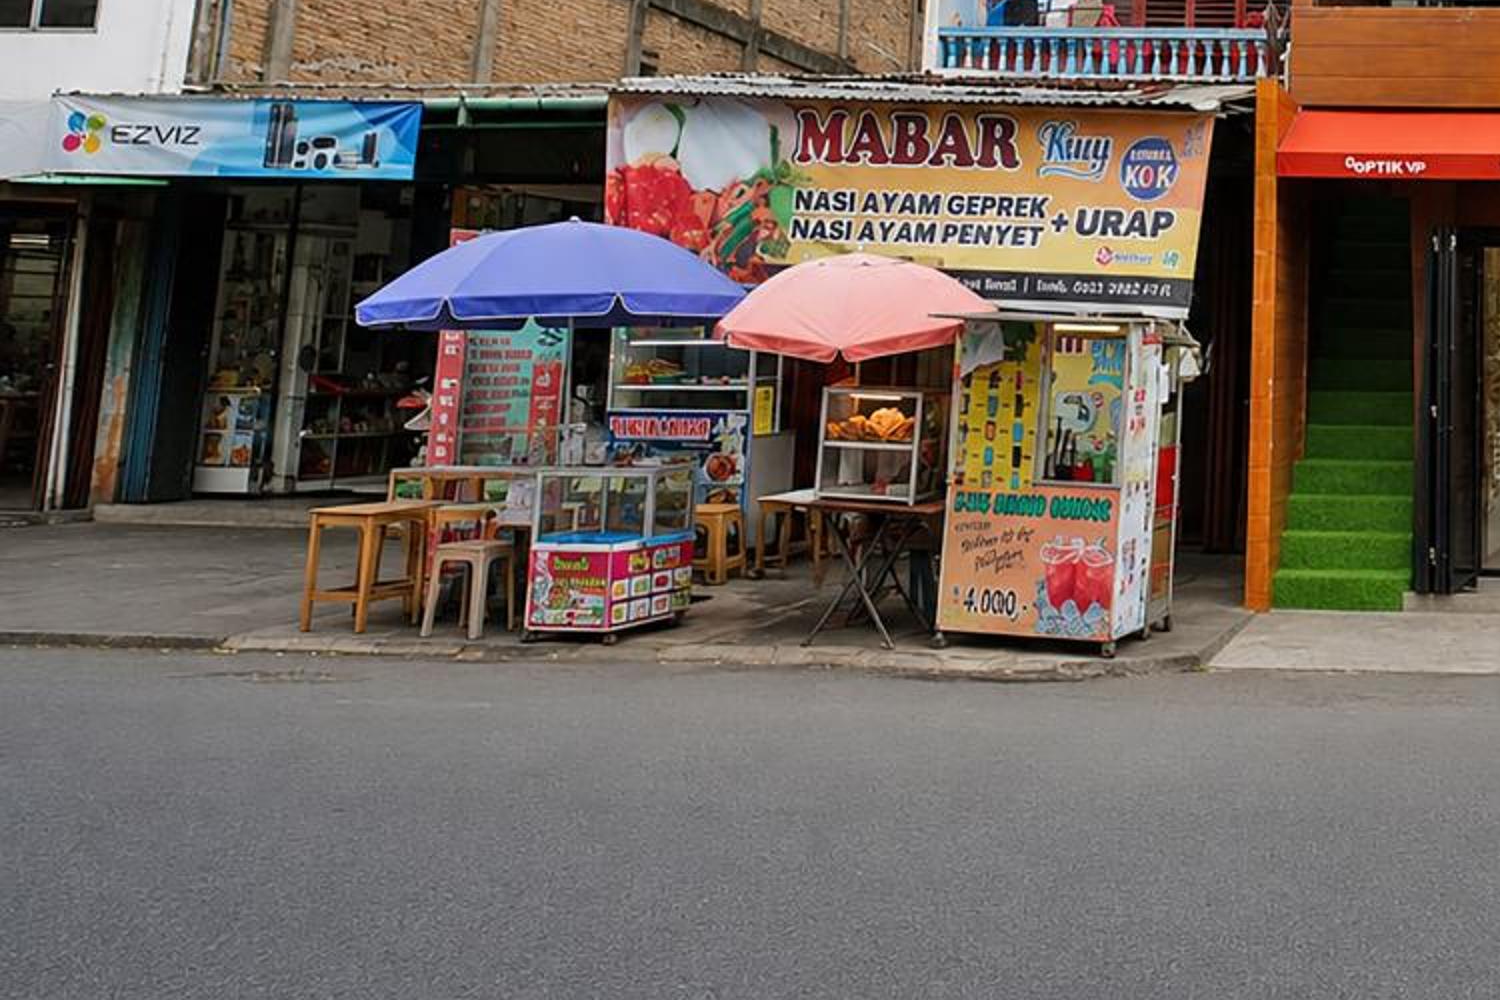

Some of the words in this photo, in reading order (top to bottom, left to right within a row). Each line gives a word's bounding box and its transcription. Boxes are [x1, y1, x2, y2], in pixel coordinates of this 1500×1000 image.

[111, 125, 200, 145] EZVIZ
[793, 109, 1020, 168] MABAR
[1125, 165, 1175, 189] KOK
[1405, 162, 1427, 174] VP
[794, 190, 856, 213] NASI
[861, 192, 942, 216] AYAM
[947, 195, 1049, 218] GEPREK
[790, 218, 852, 241] NASI
[857, 220, 935, 244] AYAM
[941, 223, 1044, 247] PENYET
[1075, 209, 1174, 238] URAP
